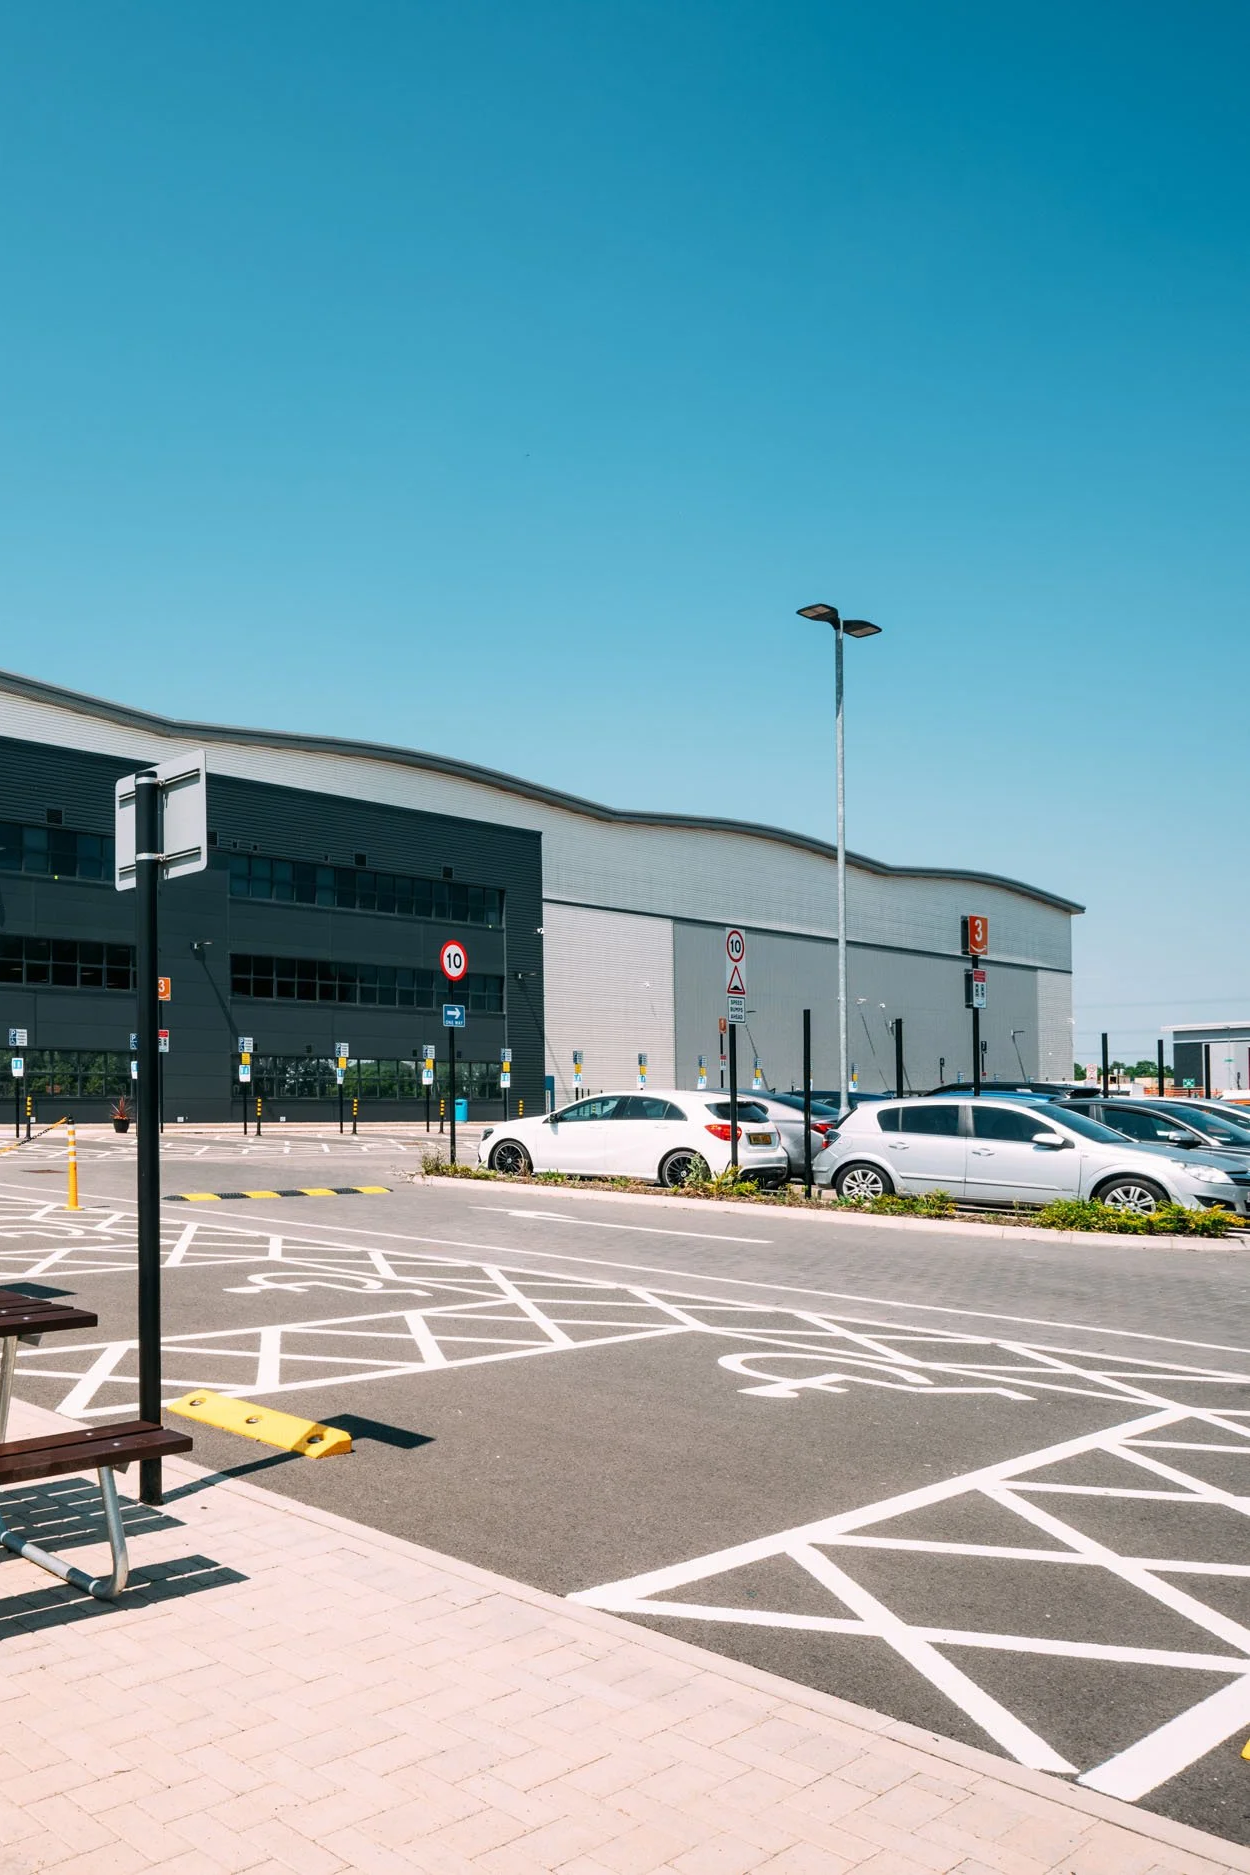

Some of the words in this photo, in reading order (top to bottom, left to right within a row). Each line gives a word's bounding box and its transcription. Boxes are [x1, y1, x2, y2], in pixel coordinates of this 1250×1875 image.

[975, 919, 982, 942] 3
[730, 939, 741, 954] 10
[446, 952, 462, 969] 10
[158, 979, 165, 993] 3
